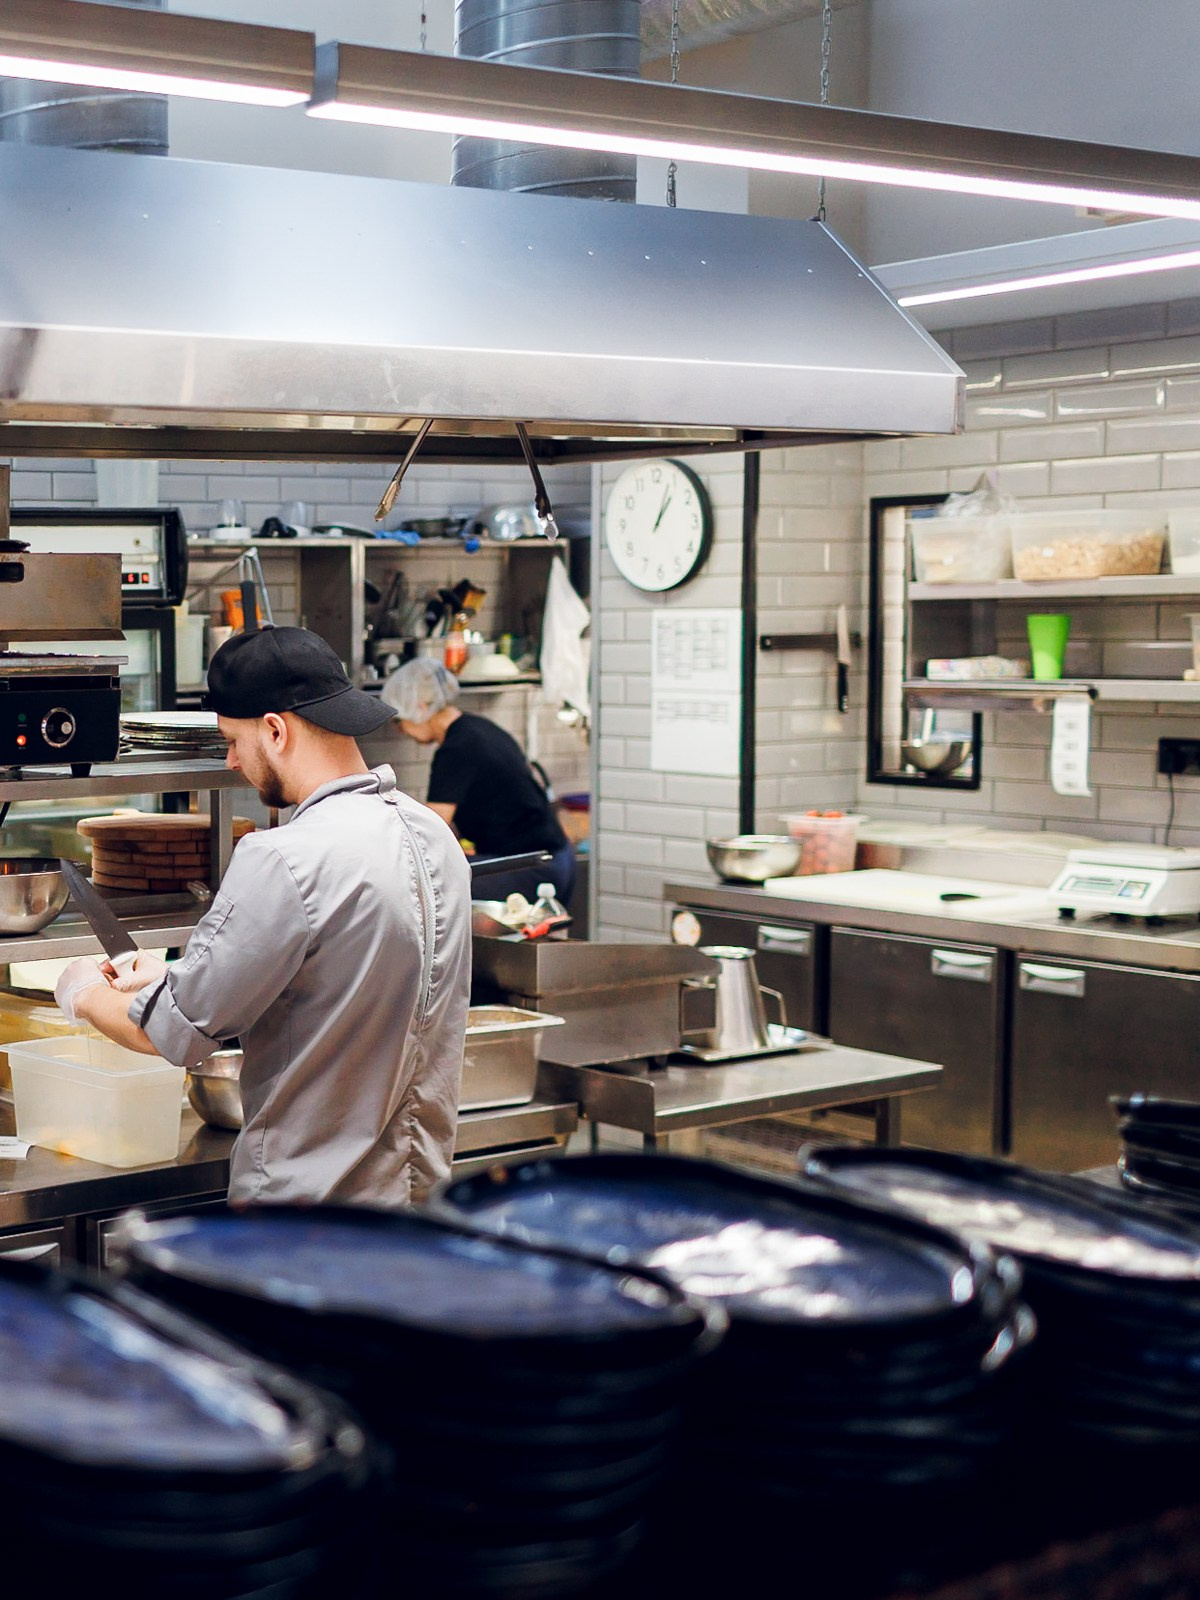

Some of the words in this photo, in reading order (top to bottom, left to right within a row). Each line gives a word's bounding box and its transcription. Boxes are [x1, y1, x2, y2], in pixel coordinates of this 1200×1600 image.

[651, 467, 662, 484] 12
[635, 478, 644, 492] 11
[625, 495, 635, 511] 10
[684, 488, 692, 505] 2
[619, 518, 627, 533] 9
[692, 513, 699, 530] 3
[626, 541, 634, 558] 8
[686, 540, 694, 553] 4
[641, 556, 649, 573] 7
[657, 563, 664, 580] 6
[674, 556, 682, 572] 5
